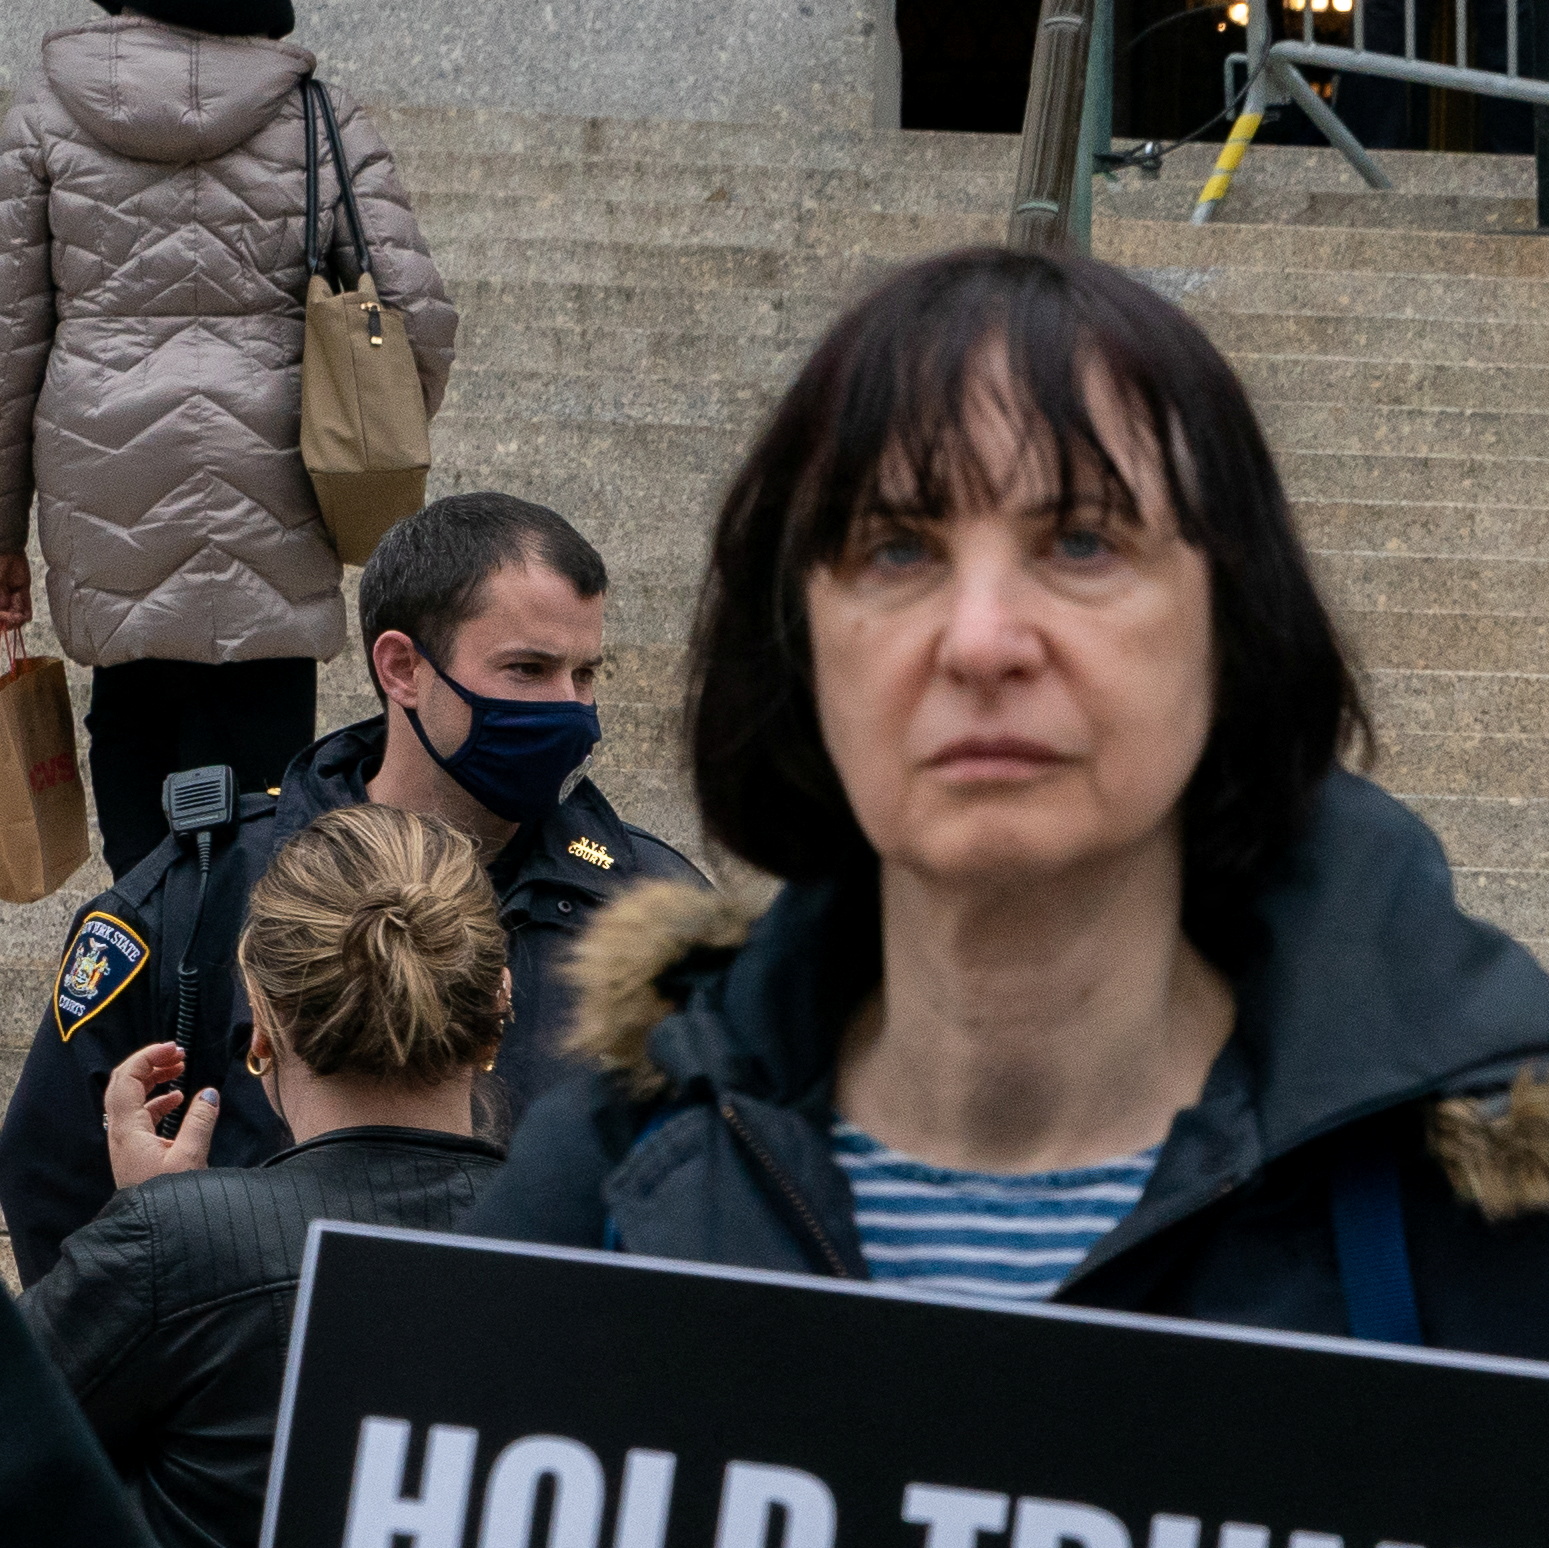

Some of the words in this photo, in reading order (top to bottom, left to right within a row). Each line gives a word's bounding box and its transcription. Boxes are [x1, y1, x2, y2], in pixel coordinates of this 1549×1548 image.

[29, 753, 76, 792] CVS
[568, 845, 611, 869] COURTS
[110, 931, 141, 962] STATE
